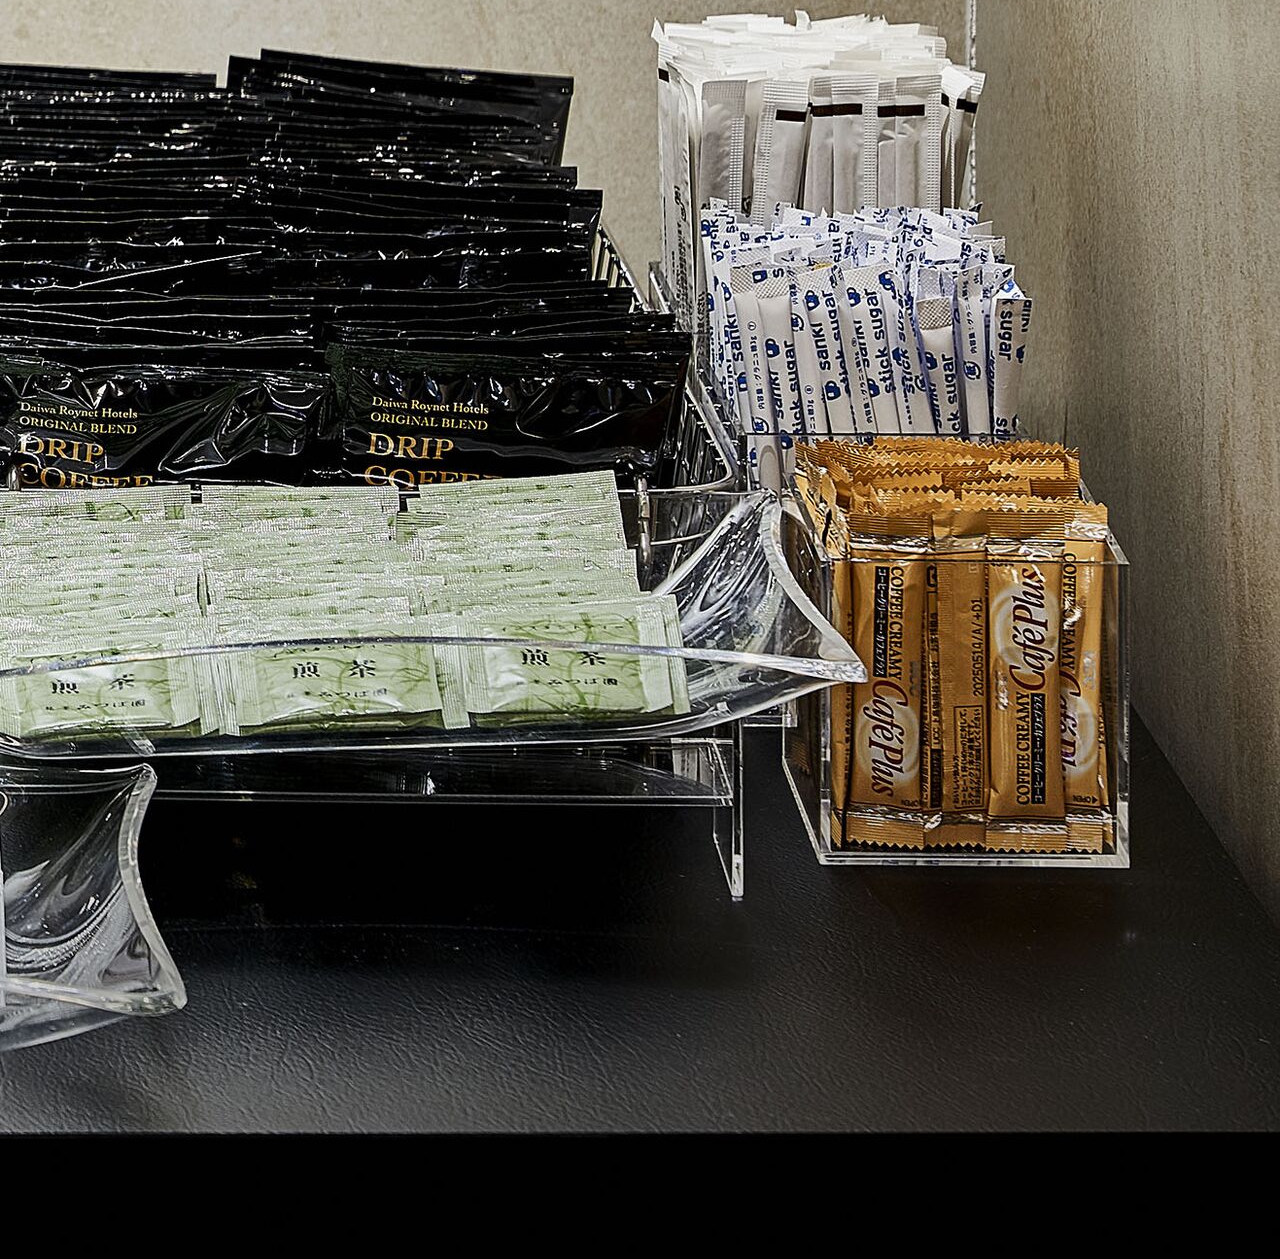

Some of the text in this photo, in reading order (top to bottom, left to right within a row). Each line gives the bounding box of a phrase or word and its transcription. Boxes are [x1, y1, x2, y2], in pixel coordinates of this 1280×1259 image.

[727, 313, 744, 361] sanki
[810, 323, 831, 370] sanki
[864, 289, 896, 394] stick sugar
[998, 310, 1013, 361] sugar
[784, 341, 798, 391] sugar
[901, 349, 915, 394] stick
[942, 354, 958, 404] sugar
[19, 416, 137, 434] ORIGINAL BLEND
[20, 402, 138, 419] Daiwa Roynet Hotels
[371, 412, 488, 431] ORIGINAL BLEND
[372, 396, 489, 414] Daiwa Roynet Hotels
[18, 433, 104, 465] DRIP
[366, 432, 454, 460] DRIP
[889, 566, 904, 681] COFFEE CREAMY
[971, 598, 984, 696] 20250514/A/+D1
[1016, 692, 1030, 805] COFFEE CREAMY
